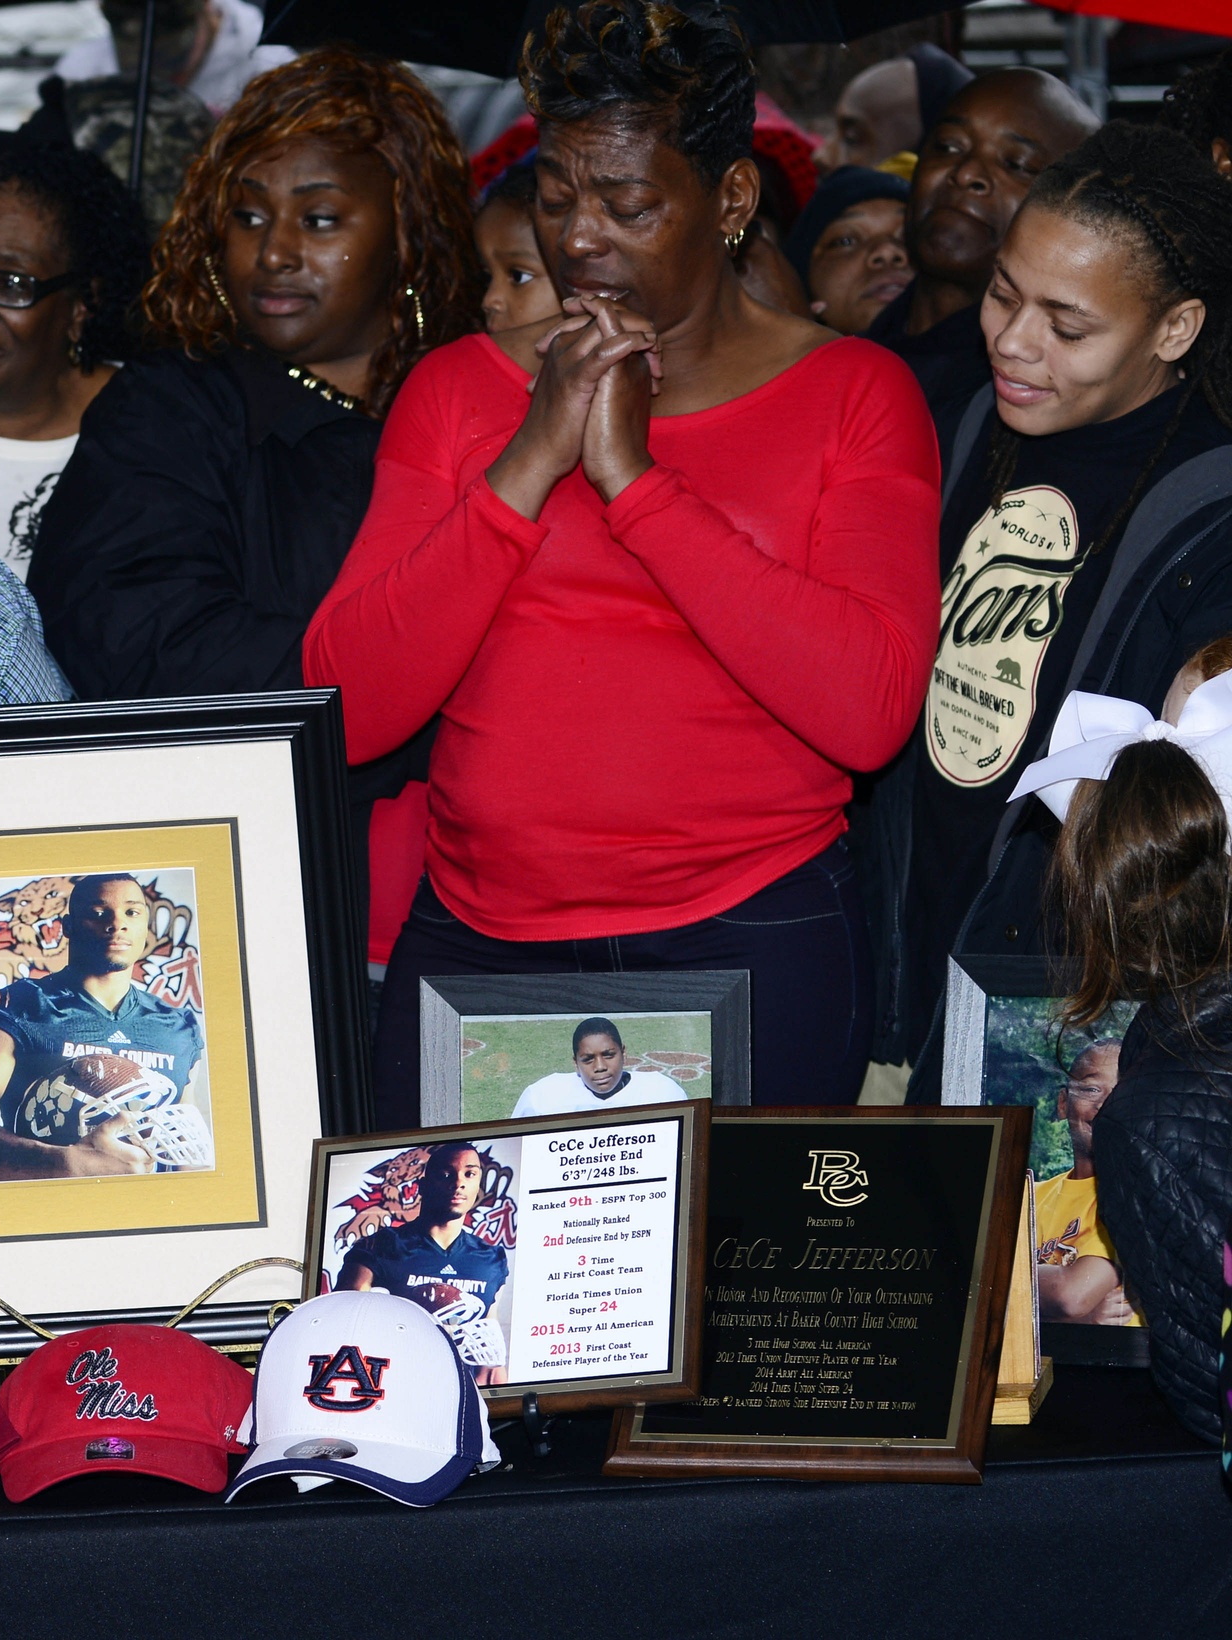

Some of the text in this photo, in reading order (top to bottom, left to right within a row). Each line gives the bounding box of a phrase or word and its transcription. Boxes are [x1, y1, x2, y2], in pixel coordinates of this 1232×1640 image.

[1000, 519, 1046, 548] WORLD'S
[957, 661, 988, 682] AUTHENTIC
[945, 673, 960, 694] THE
[960, 680, 979, 704] WALL
[979, 689, 1015, 717] BREWED
[548, 1133, 656, 1153] CeCe Jefferson
[559, 1149, 643, 1167] Defensive End
[619, 1165, 639, 1176] lbs.
[532, 1191, 667, 1211] Ranked 9th ESPN Top 300
[563, 1214, 631, 1228] Nationally Ranked
[543, 1229, 652, 1247] 2nd Defensive End by ESPN
[577, 1255, 615, 1266] 3 Time
[547, 1265, 644, 1281] All First Coast Team
[546, 1286, 643, 1302] Florida Times Union
[569, 1300, 618, 1316] Super 24
[530, 1319, 654, 1337] 2015 Army All American
[550, 1341, 632, 1355] 2013 First Coast
[716, 1351, 735, 1363] 2012
[66, 1347, 118, 1386] Ole
[532, 1351, 648, 1369] Defensive Player of the Year
[755, 1366, 774, 1378] 2014
[749, 1381, 768, 1393] 2014
[842, 1383, 854, 1395] 24
[76, 1380, 159, 1422] Miss
